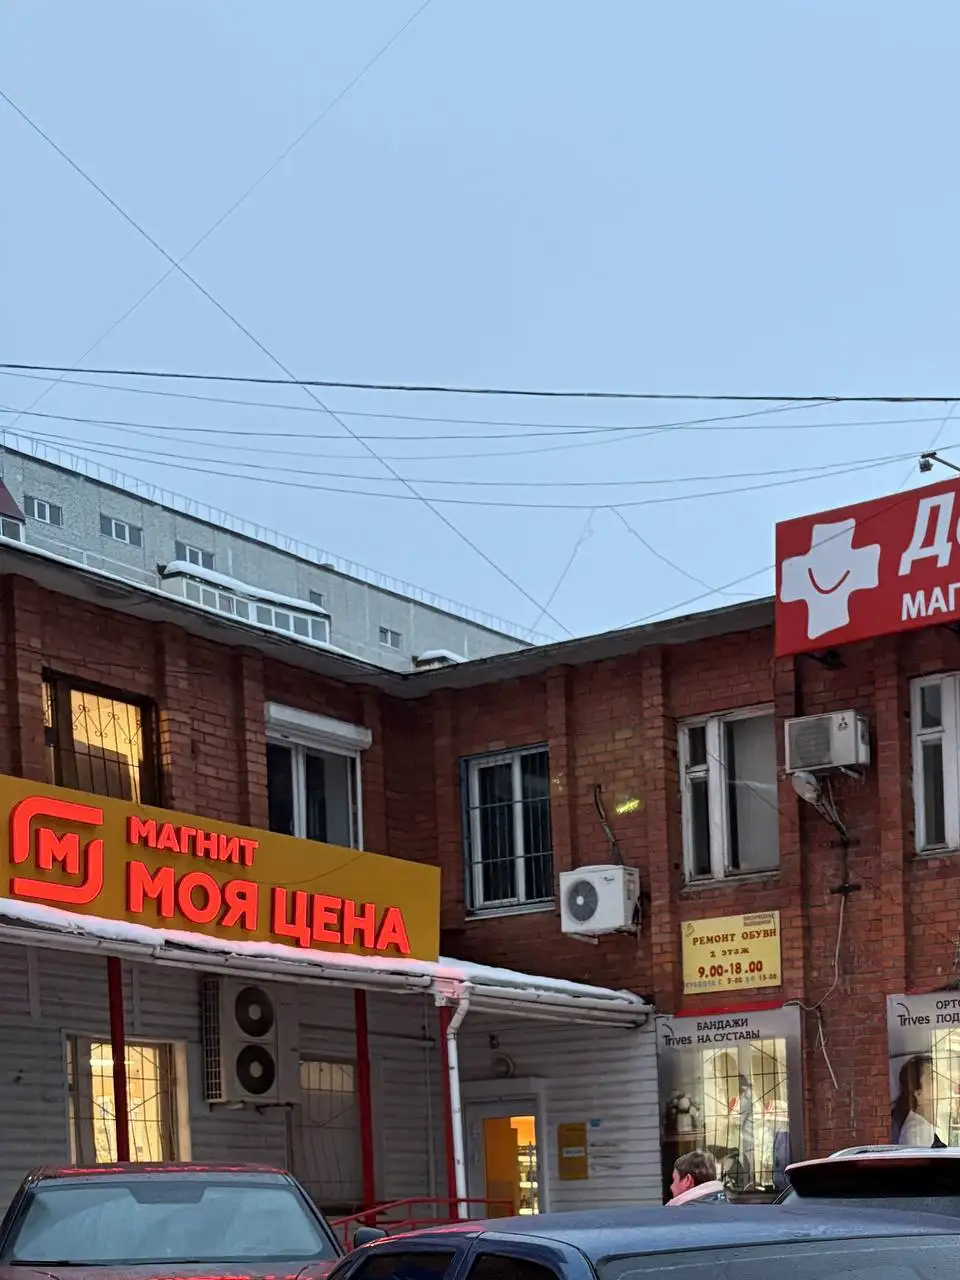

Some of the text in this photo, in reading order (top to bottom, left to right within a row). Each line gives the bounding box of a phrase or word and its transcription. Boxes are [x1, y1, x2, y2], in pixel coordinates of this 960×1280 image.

[128, 815, 259, 867] МАГНИТ
[128, 860, 412, 954] МОЯ ЦЕНА
[692, 933, 736, 946] РЕМОНТ
[697, 960, 763, 979] 9.00-18.00
[697, 1018, 749, 1031] БАНДАЖИ
[897, 1014, 930, 1026] Trives
[662, 1034, 692, 1046] Trives
[697, 1030, 760, 1044] НА СУСТАВЫ
